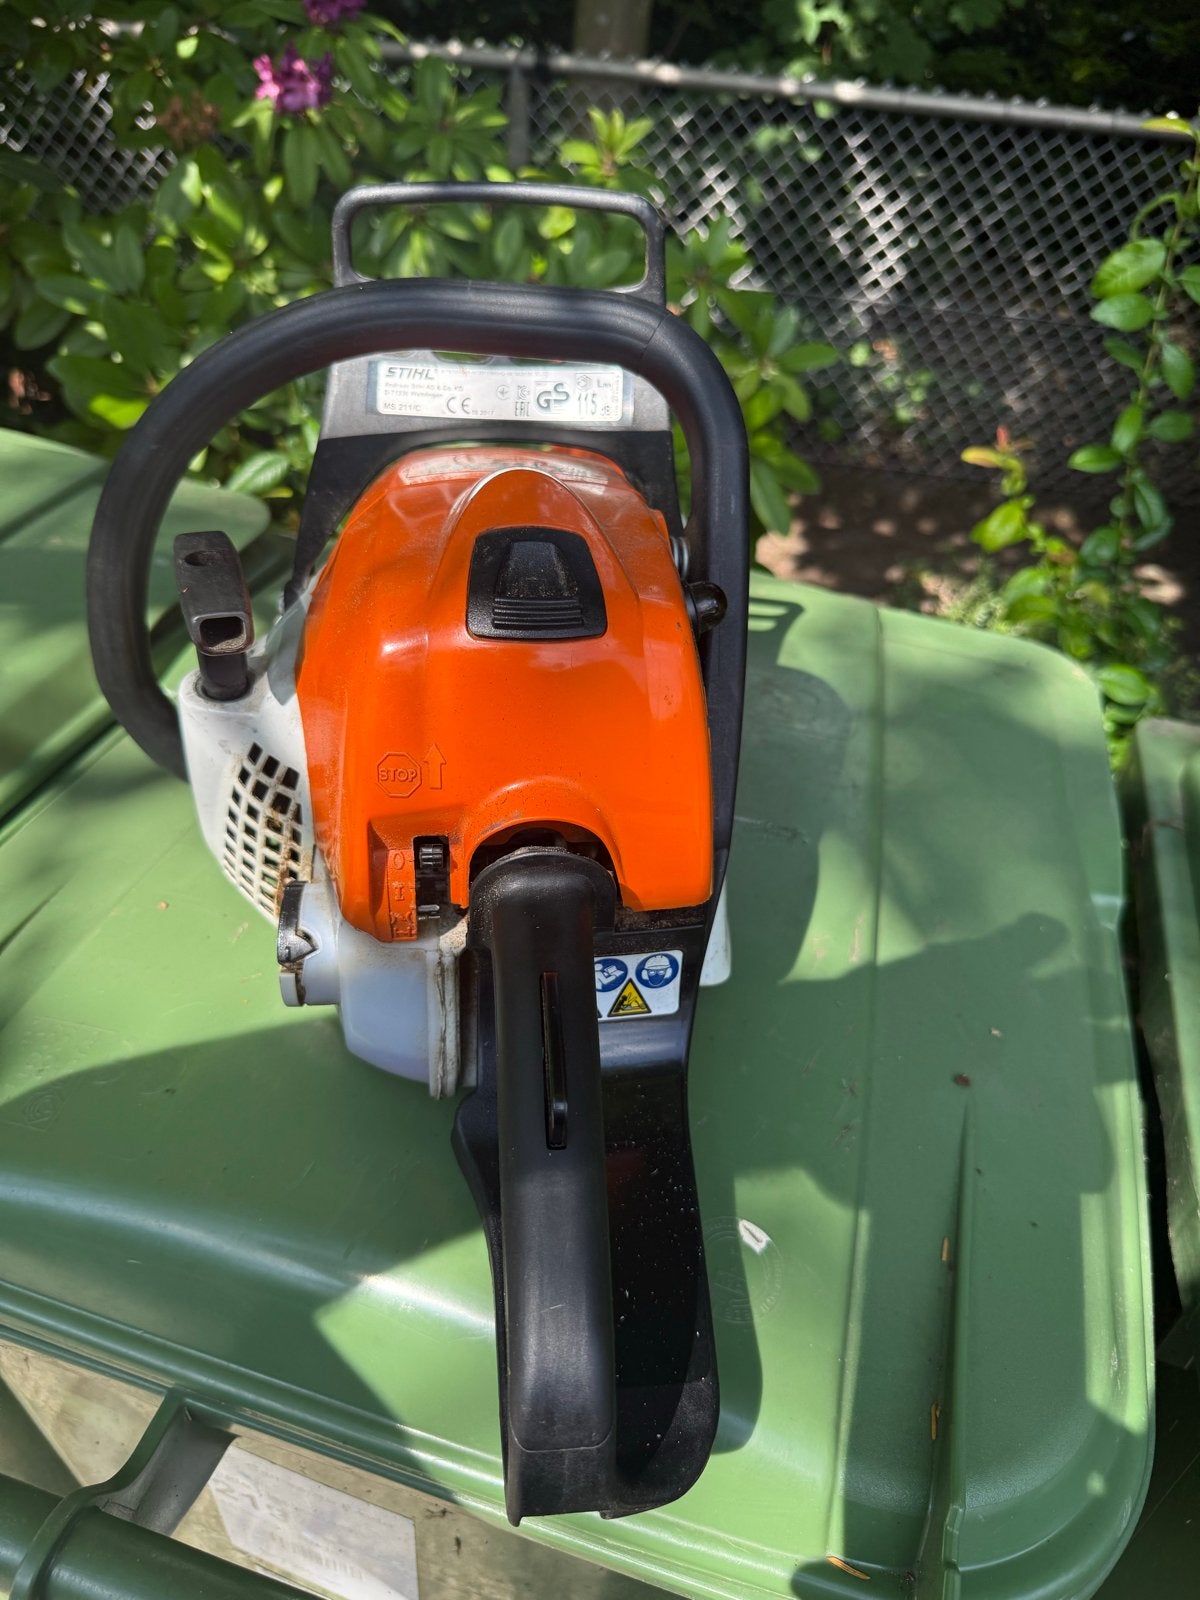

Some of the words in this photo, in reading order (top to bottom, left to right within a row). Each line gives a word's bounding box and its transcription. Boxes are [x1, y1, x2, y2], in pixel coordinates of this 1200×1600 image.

[386, 367, 435, 380] STIHL
[536, 382, 570, 411] GS
[378, 767, 418, 783] STOP
